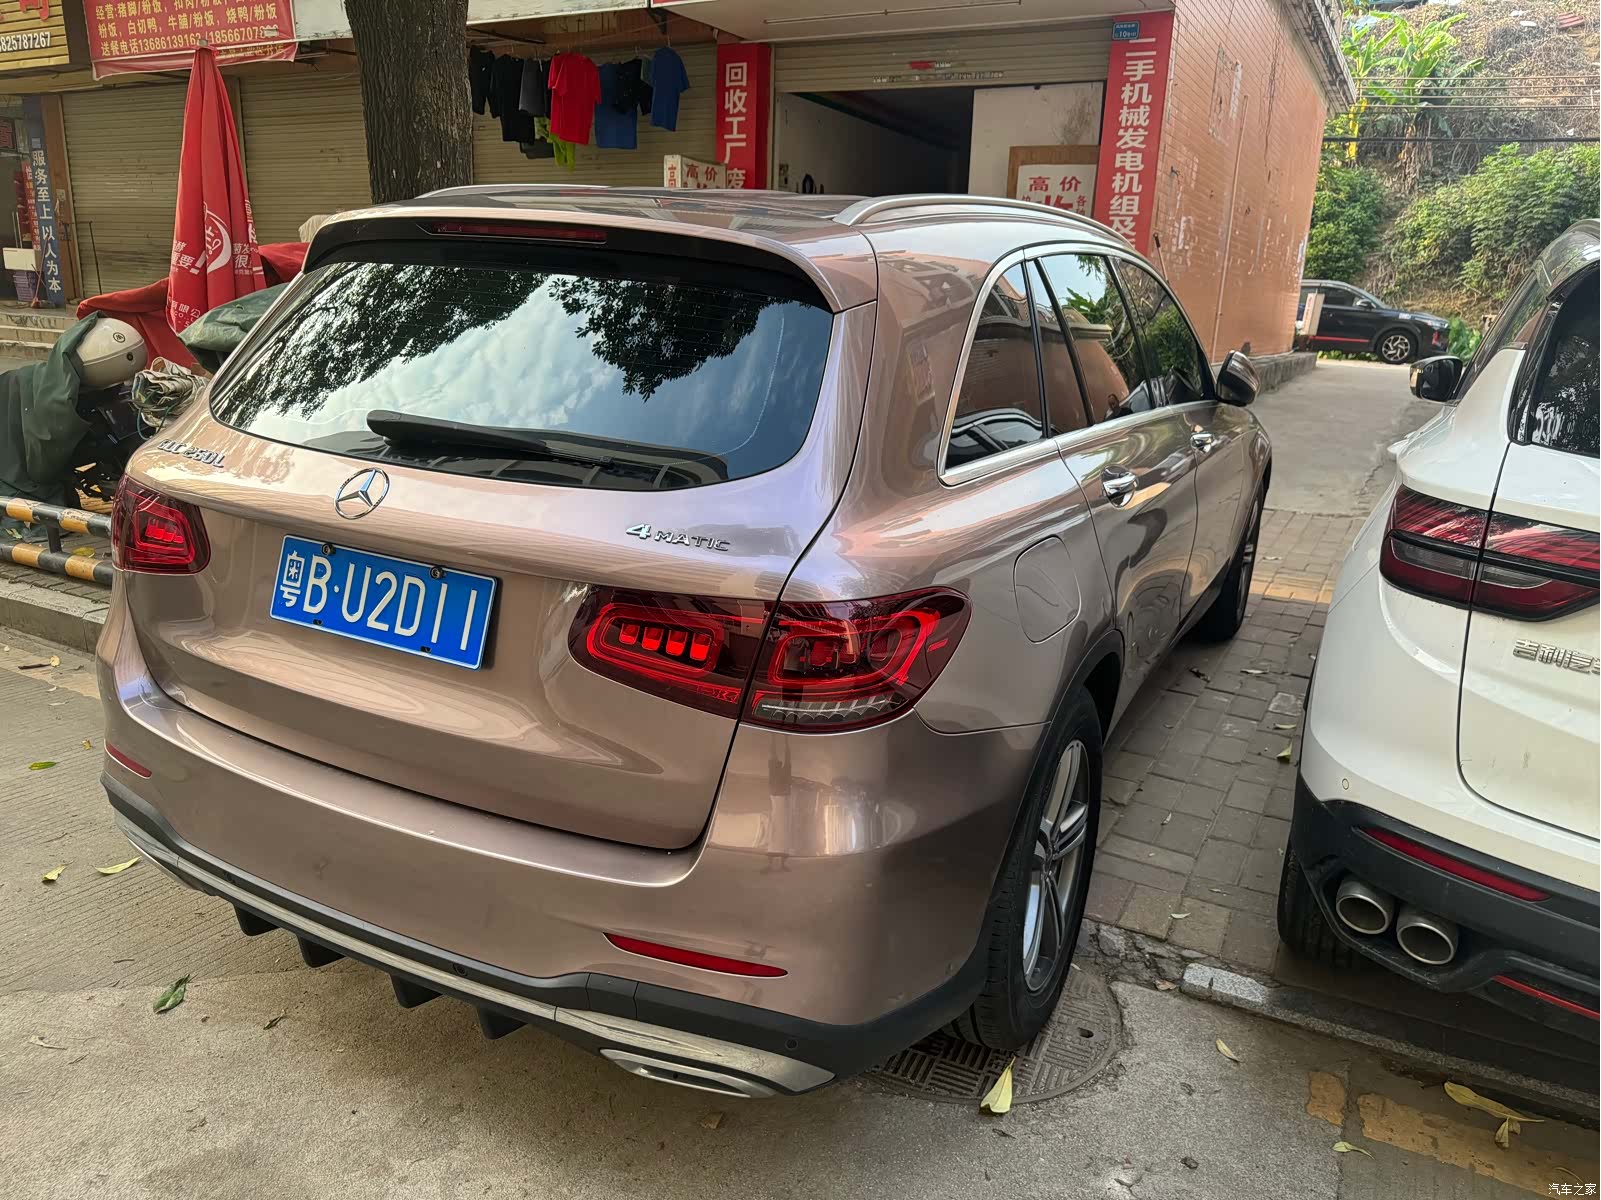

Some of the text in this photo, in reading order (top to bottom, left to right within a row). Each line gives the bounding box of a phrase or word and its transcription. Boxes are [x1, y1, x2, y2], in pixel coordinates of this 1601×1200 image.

[0, 32, 51, 52] 825787267
[723, 62, 748, 188] 回收工厂废
[1108, 37, 1157, 248] 二手机械发电机组及
[32, 150, 62, 293] 服务至上以人为本
[1028, 176, 1082, 192] 高价
[157, 438, 226, 468] GLC 260L
